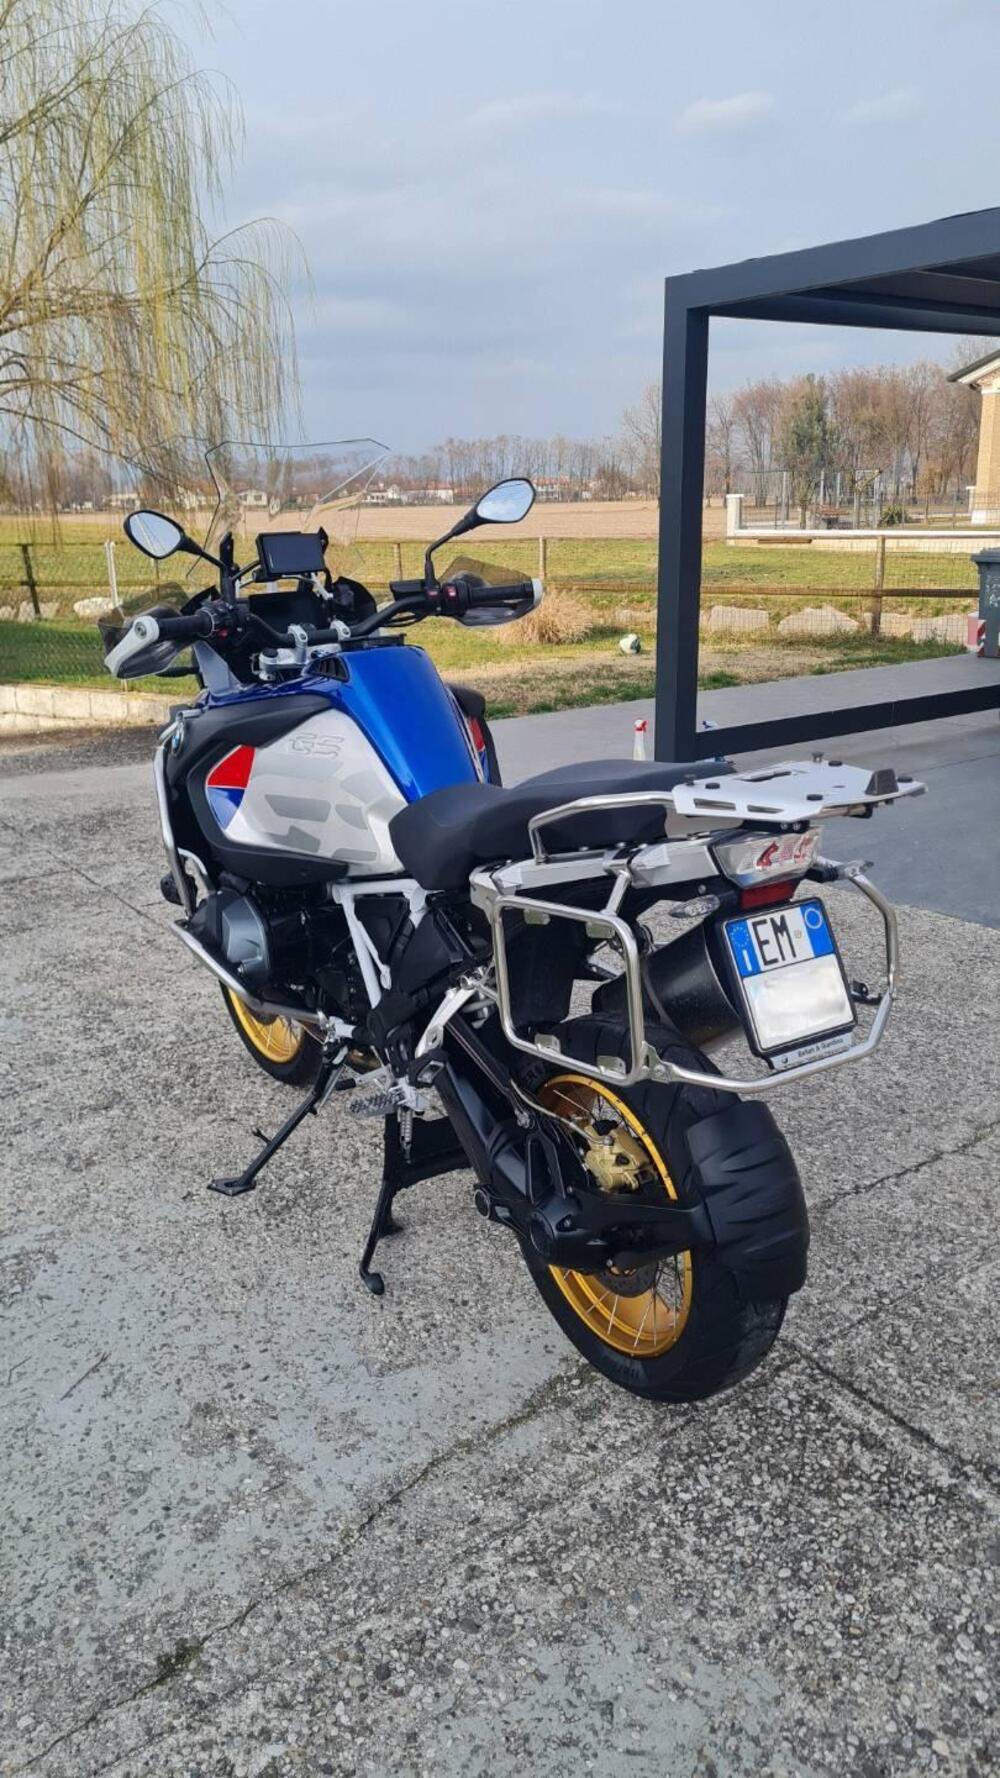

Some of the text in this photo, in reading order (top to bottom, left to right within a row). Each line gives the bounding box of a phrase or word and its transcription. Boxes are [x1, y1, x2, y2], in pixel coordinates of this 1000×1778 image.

[289, 731, 345, 758] GS
[752, 914, 797, 966] EM
[743, 950, 752, 971] I
